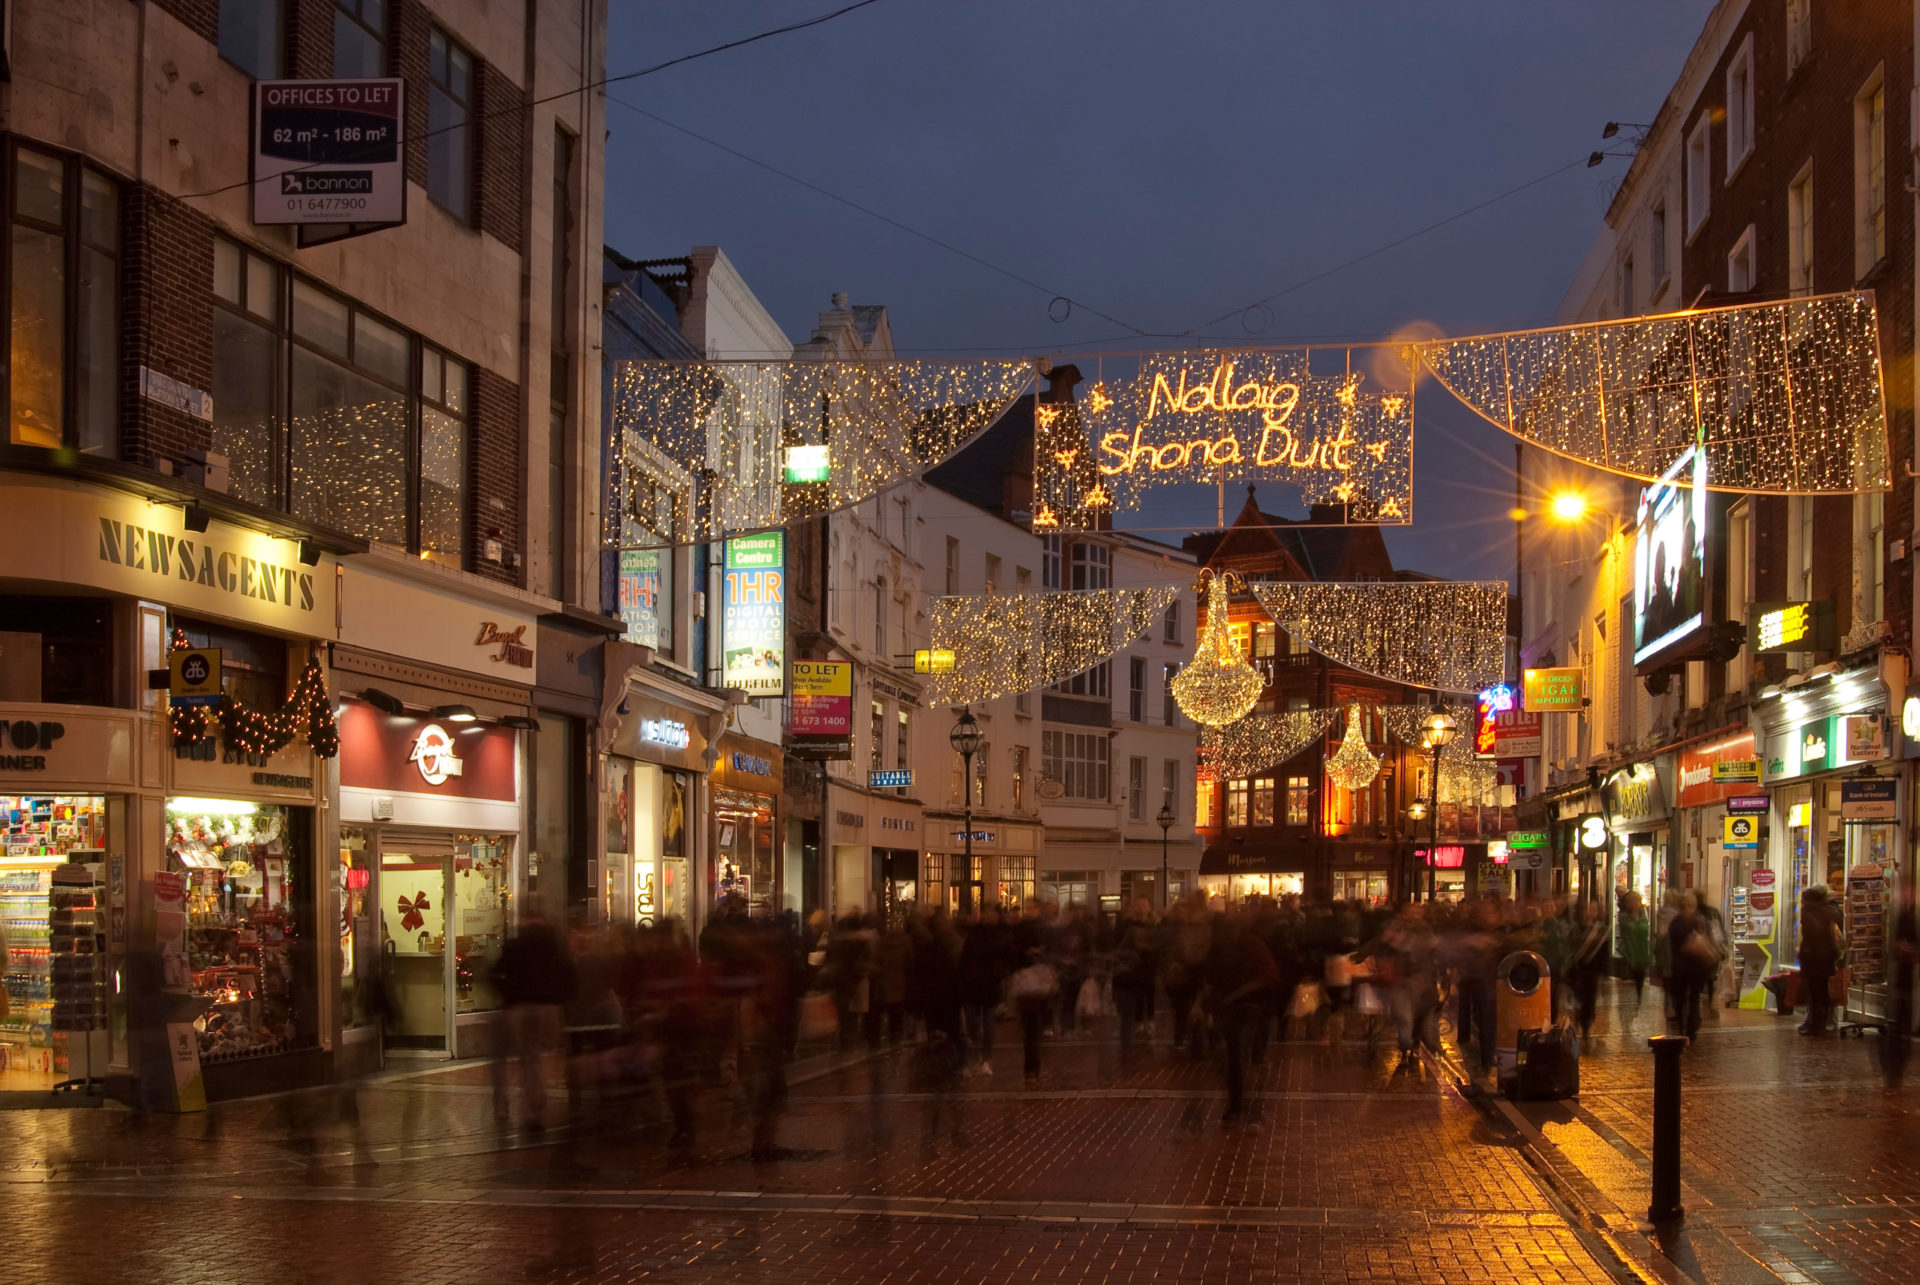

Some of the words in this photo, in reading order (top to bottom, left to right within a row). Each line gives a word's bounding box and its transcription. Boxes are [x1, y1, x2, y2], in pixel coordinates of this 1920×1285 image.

[268, 89, 334, 104] OFFICES
[337, 87, 360, 103] TO
[364, 87, 392, 103] LET
[273, 129, 292, 142] 62
[333, 127, 361, 141] 186
[306, 177, 369, 190] bannon
[287, 199, 303, 210] 01
[308, 198, 366, 210] 6477900
[1099, 424, 1244, 475] Shona
[1256, 424, 1355, 469] Duit
[732, 537, 776, 549] Camera
[735, 551, 774, 564] Centre
[99, 517, 315, 612] NEWSAGENTS
[726, 571, 783, 604] 1HR
[727, 606, 782, 617] DIGITAL
[727, 617, 781, 630] PHOTO
[727, 630, 782, 642] SERVICE
[793, 664, 811, 674] TO
[816, 664, 840, 675] LET
[726, 678, 782, 690] FUJIFILM
[802, 717, 820, 725] 673
[823, 717, 845, 725] 1400
[1496, 711, 1514, 726] TO
[1517, 711, 1538, 725] LET
[253, 772, 312, 789] NEWSAGENTS
[870, 771, 911, 779] SUITABLE
[1511, 832, 1548, 842] CIGARS
[1581, 816, 1607, 849] 3
[1480, 869, 1511, 877] SALE
